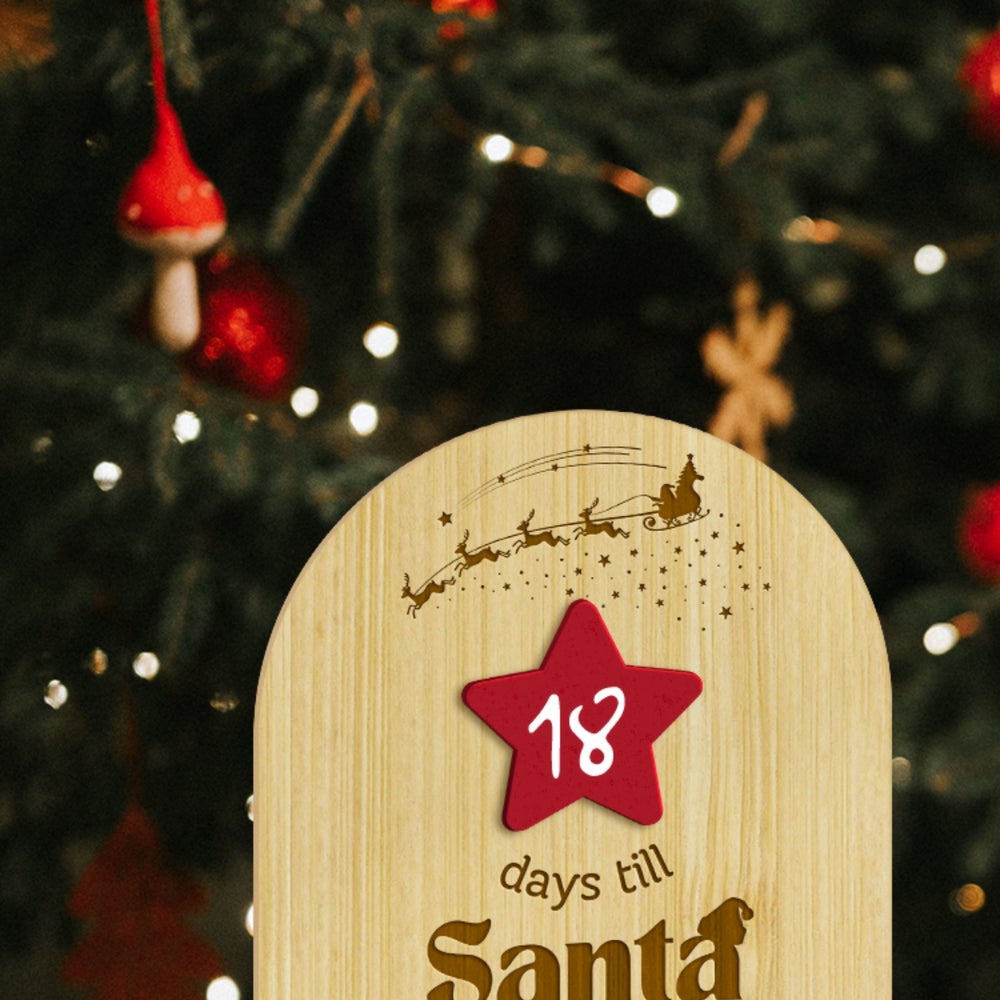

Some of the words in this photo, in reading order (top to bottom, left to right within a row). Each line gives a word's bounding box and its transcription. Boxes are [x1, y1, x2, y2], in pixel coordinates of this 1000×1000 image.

[528, 686, 626, 779] 18
[500, 855, 601, 911] days
[616, 844, 674, 894] till
